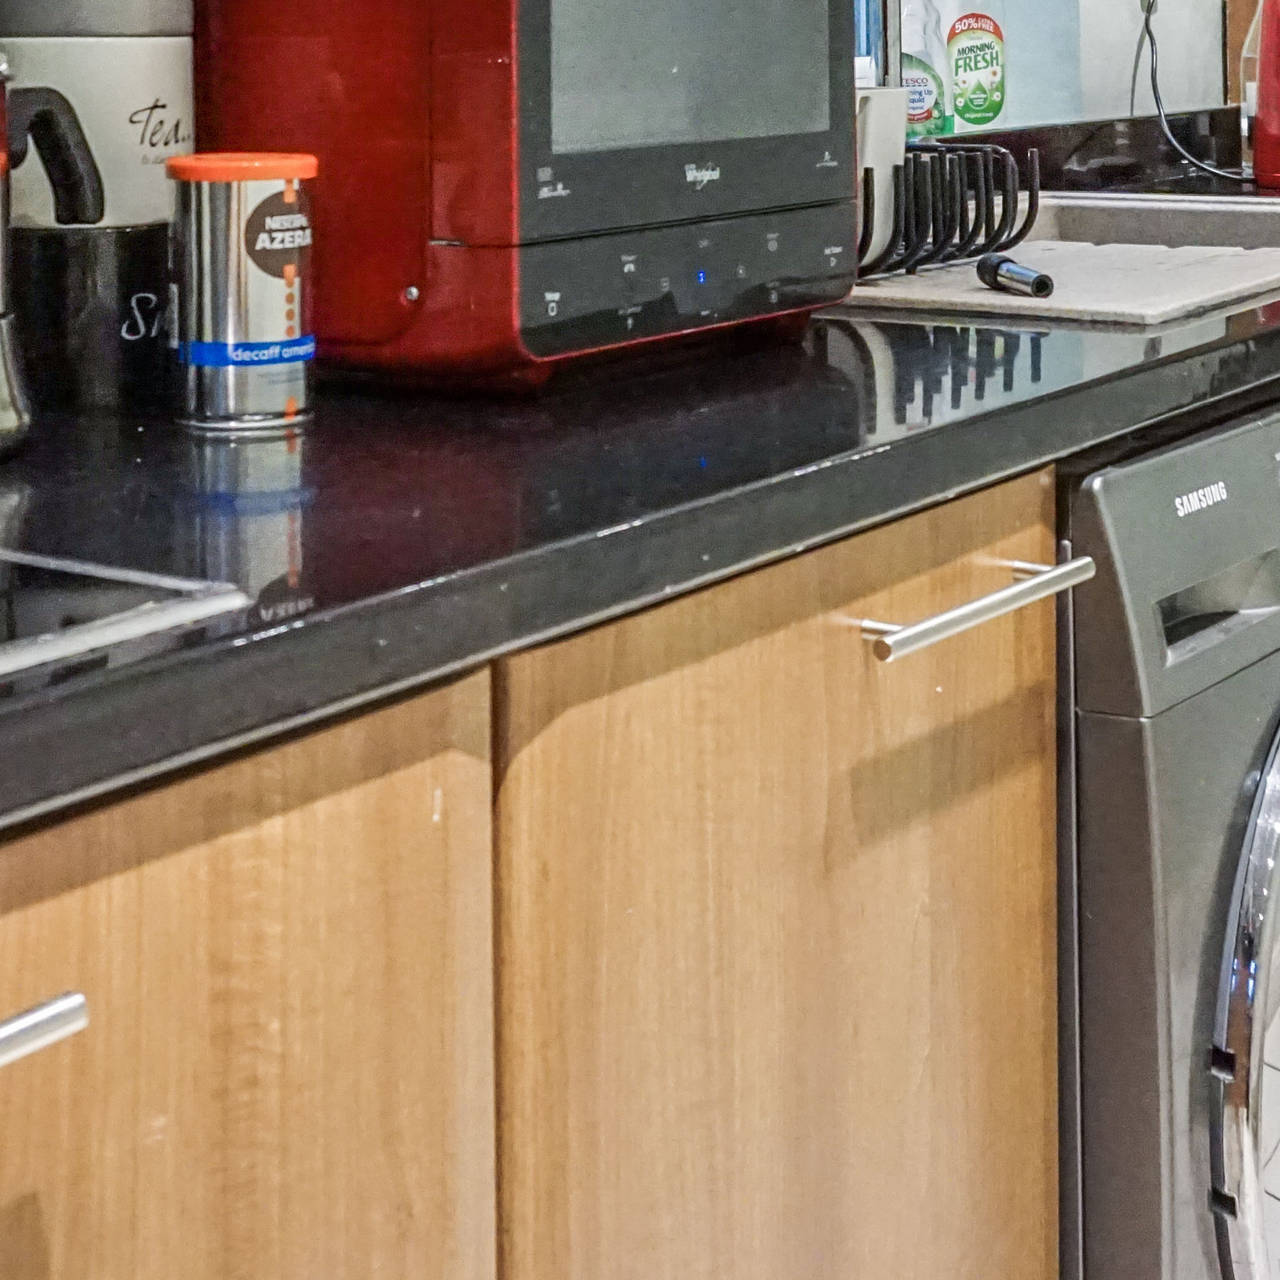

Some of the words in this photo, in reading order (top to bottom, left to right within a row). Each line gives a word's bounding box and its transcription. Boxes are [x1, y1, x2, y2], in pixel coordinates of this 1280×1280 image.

[956, 40, 995, 57] MORNING
[954, 50, 999, 77] FRESH
[231, 345, 281, 362] decaff
[1175, 481, 1227, 517] SAMSUNG
